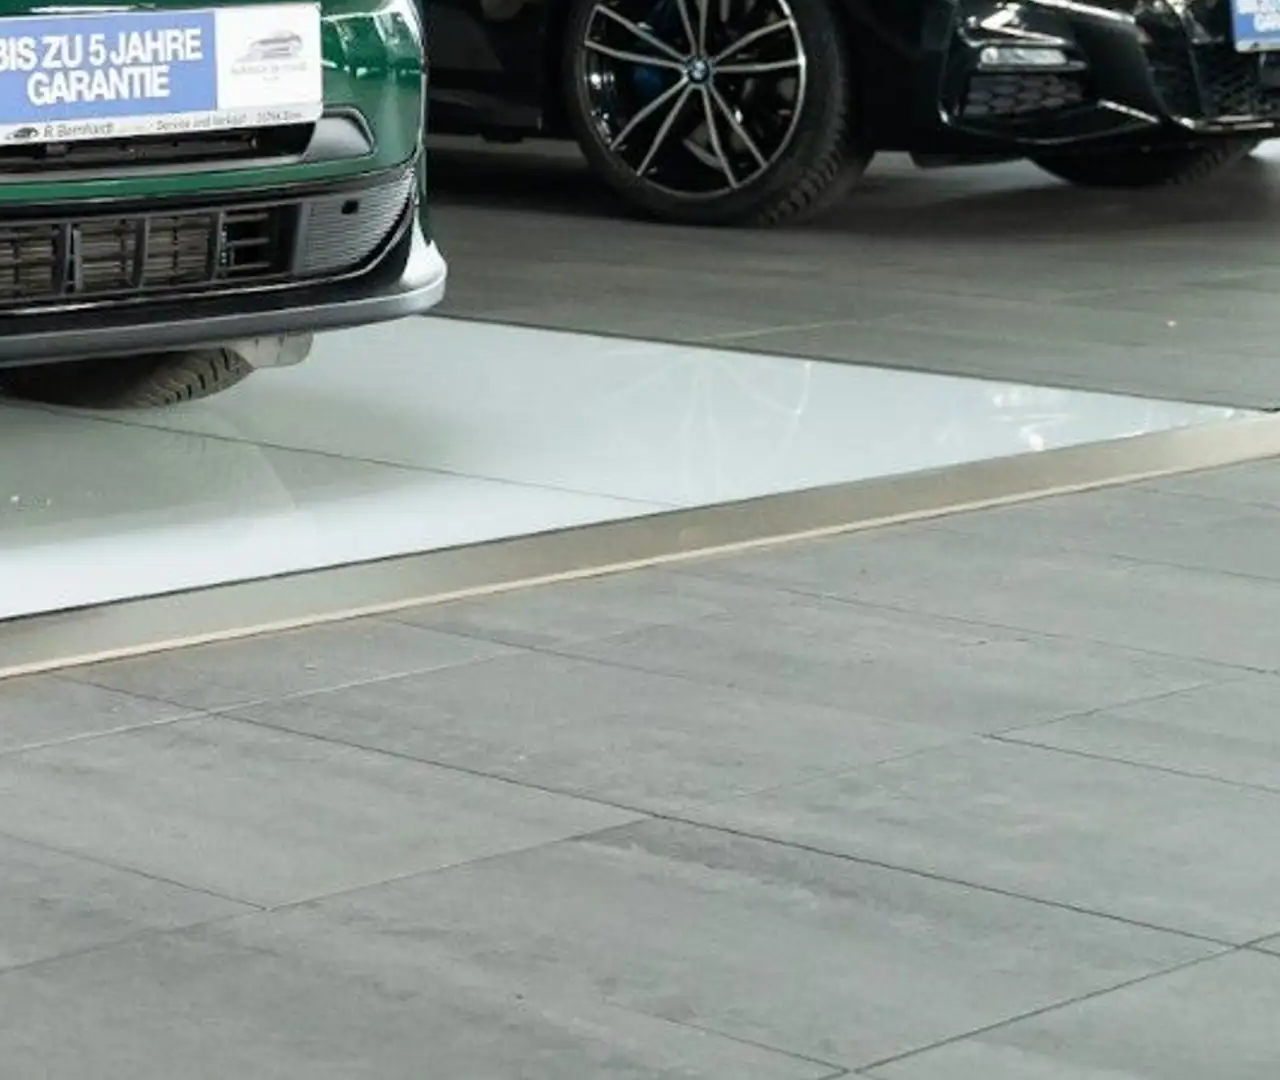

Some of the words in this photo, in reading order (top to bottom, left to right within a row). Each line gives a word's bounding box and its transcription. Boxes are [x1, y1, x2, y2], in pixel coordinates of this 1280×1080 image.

[41, 34, 83, 69] ZU
[88, 33, 107, 66] 5
[109, 27, 204, 66] JAHRE
[27, 64, 171, 106] GARANTIE
